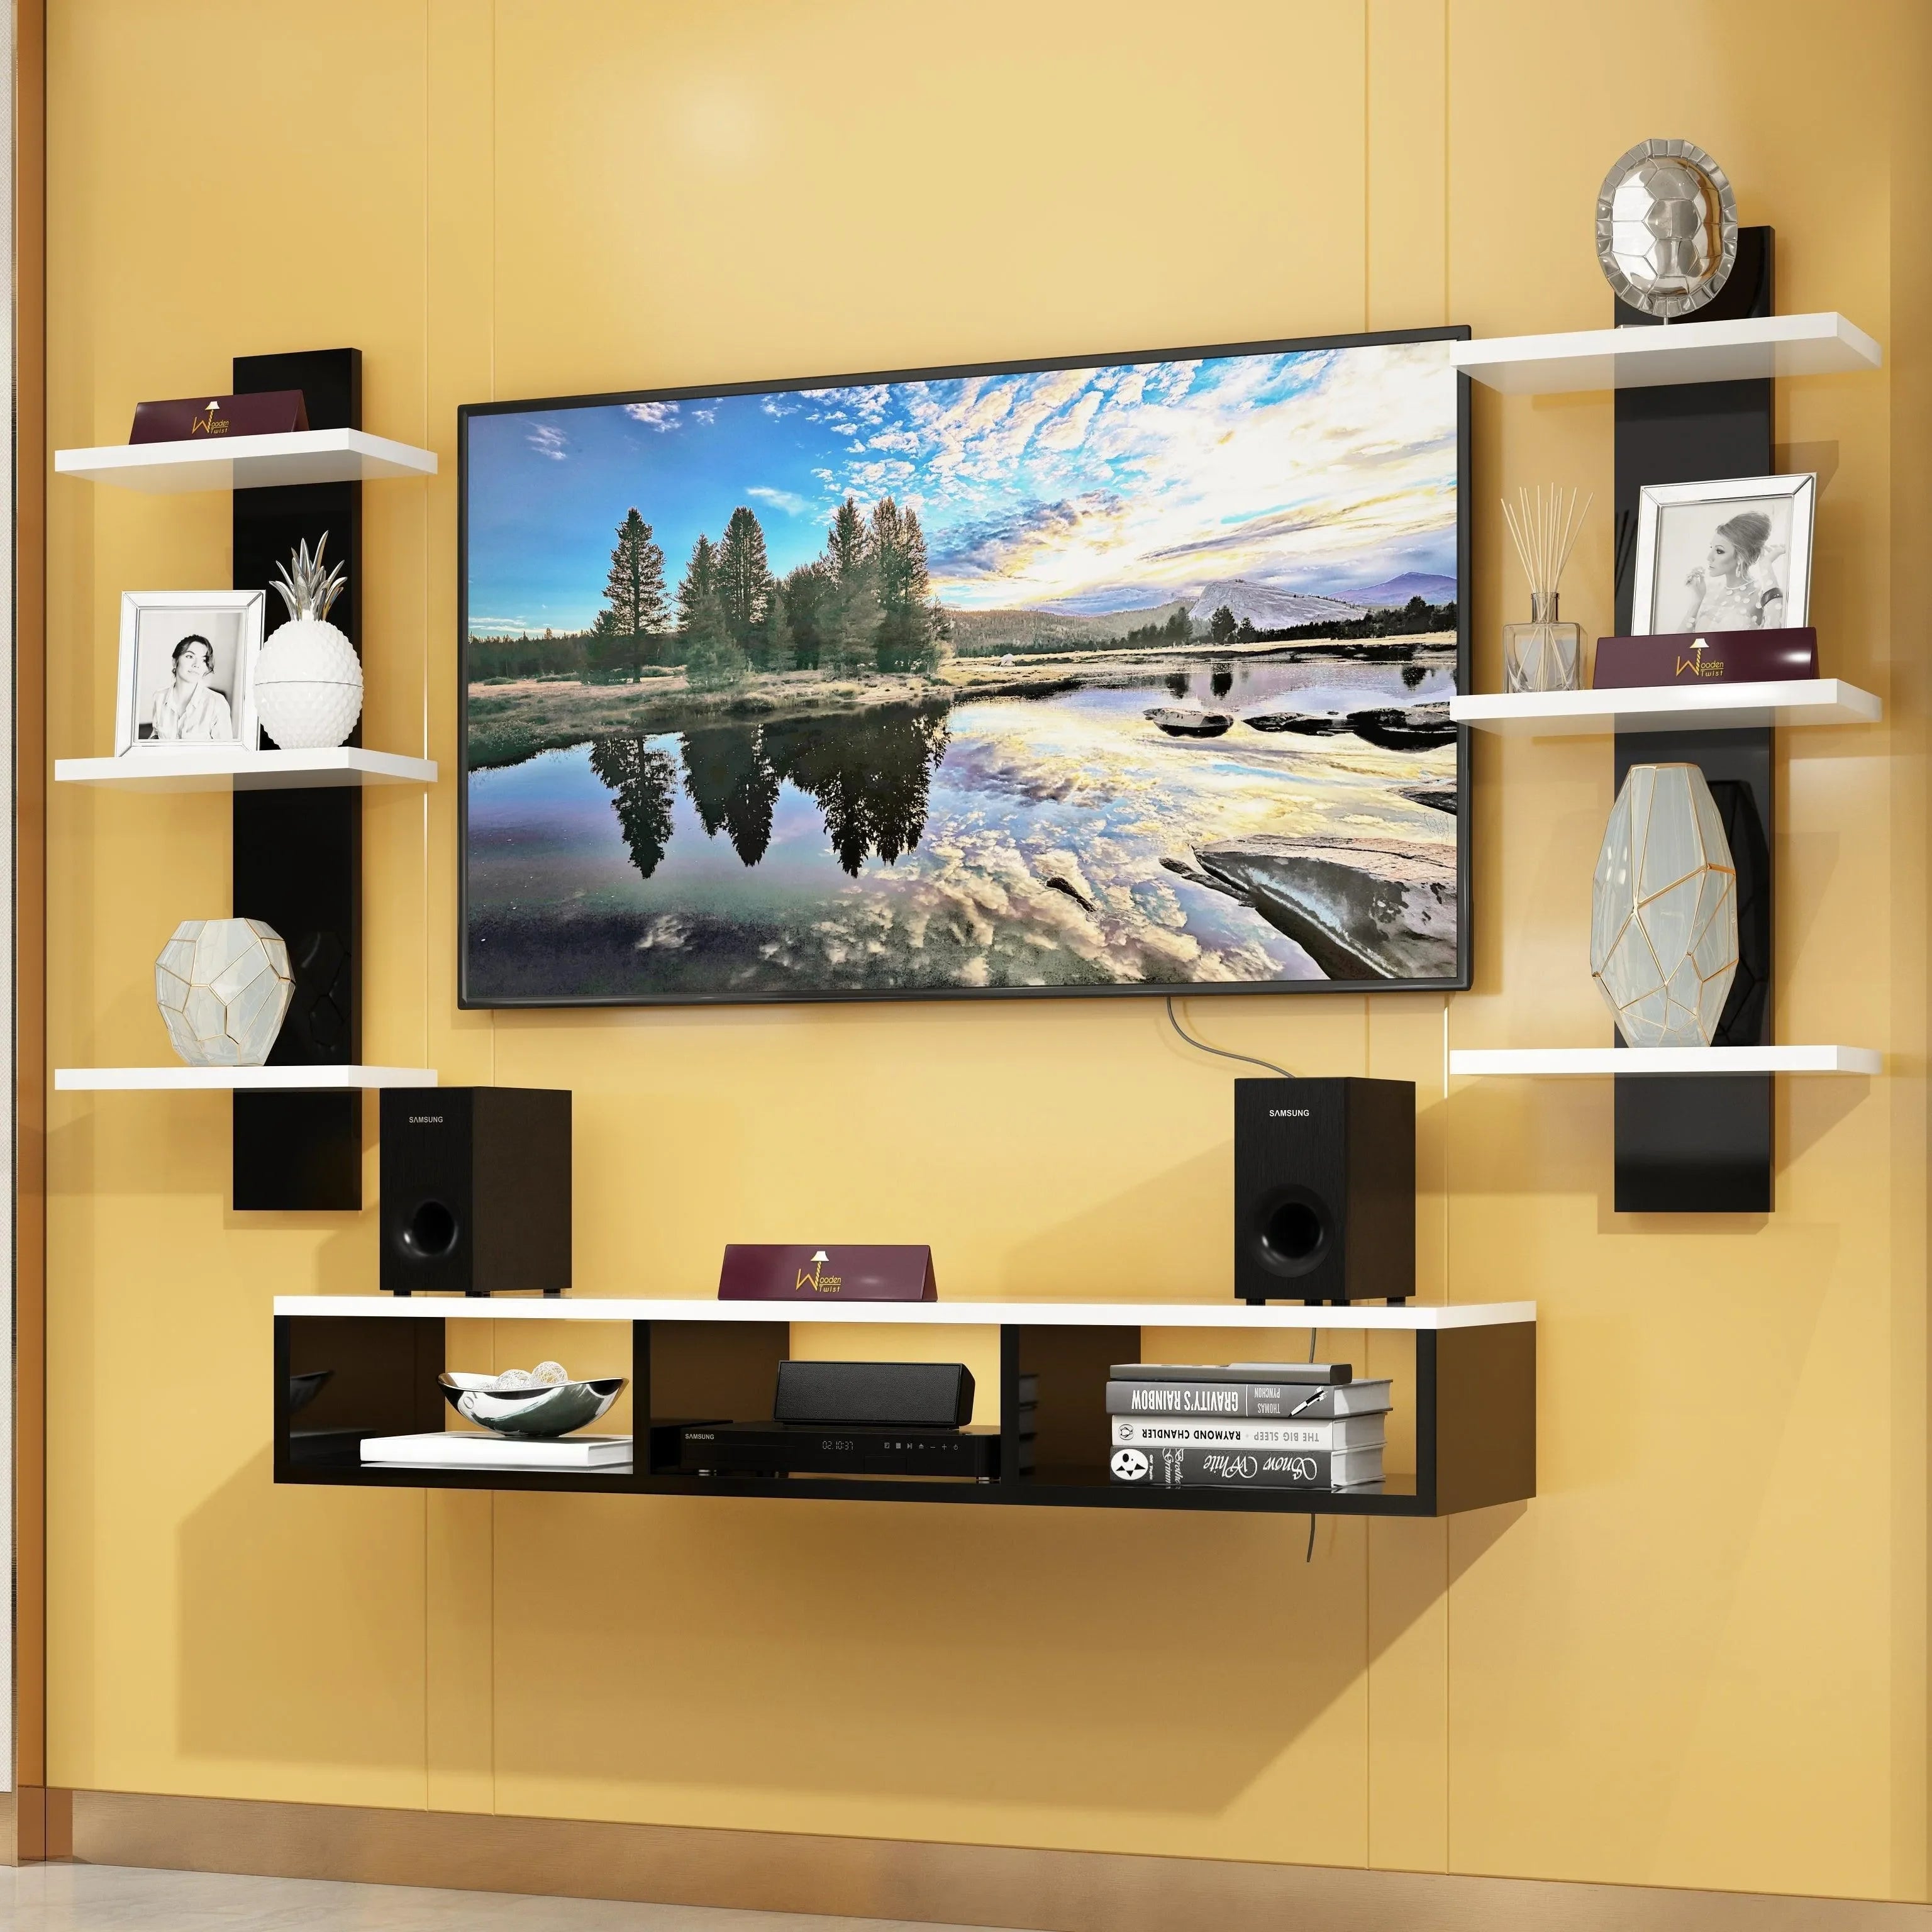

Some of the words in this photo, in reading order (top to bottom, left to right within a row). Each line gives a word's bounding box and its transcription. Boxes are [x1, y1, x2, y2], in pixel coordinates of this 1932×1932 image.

[192, 409, 229, 434] Wooden
[1676, 648, 1724, 677] Wooden
[796, 1262, 841, 1291] Wooden
[1131, 1390, 1181, 1411] RAINBOW
[1254, 1387, 1280, 1399] PYNCHON
[1184, 1391, 1238, 1412] GRAVITY'S
[1257, 1403, 1280, 1414] THOMAS
[1142, 1429, 1190, 1439] CHANDLER
[1194, 1430, 1241, 1440] RAYMOND
[1253, 1431, 1279, 1441] SLEEP
[1283, 1432, 1299, 1441] BIG
[1302, 1433, 1319, 1442] THE
[1203, 1455, 1258, 1478] White
[1262, 1457, 1318, 1480] Snow
